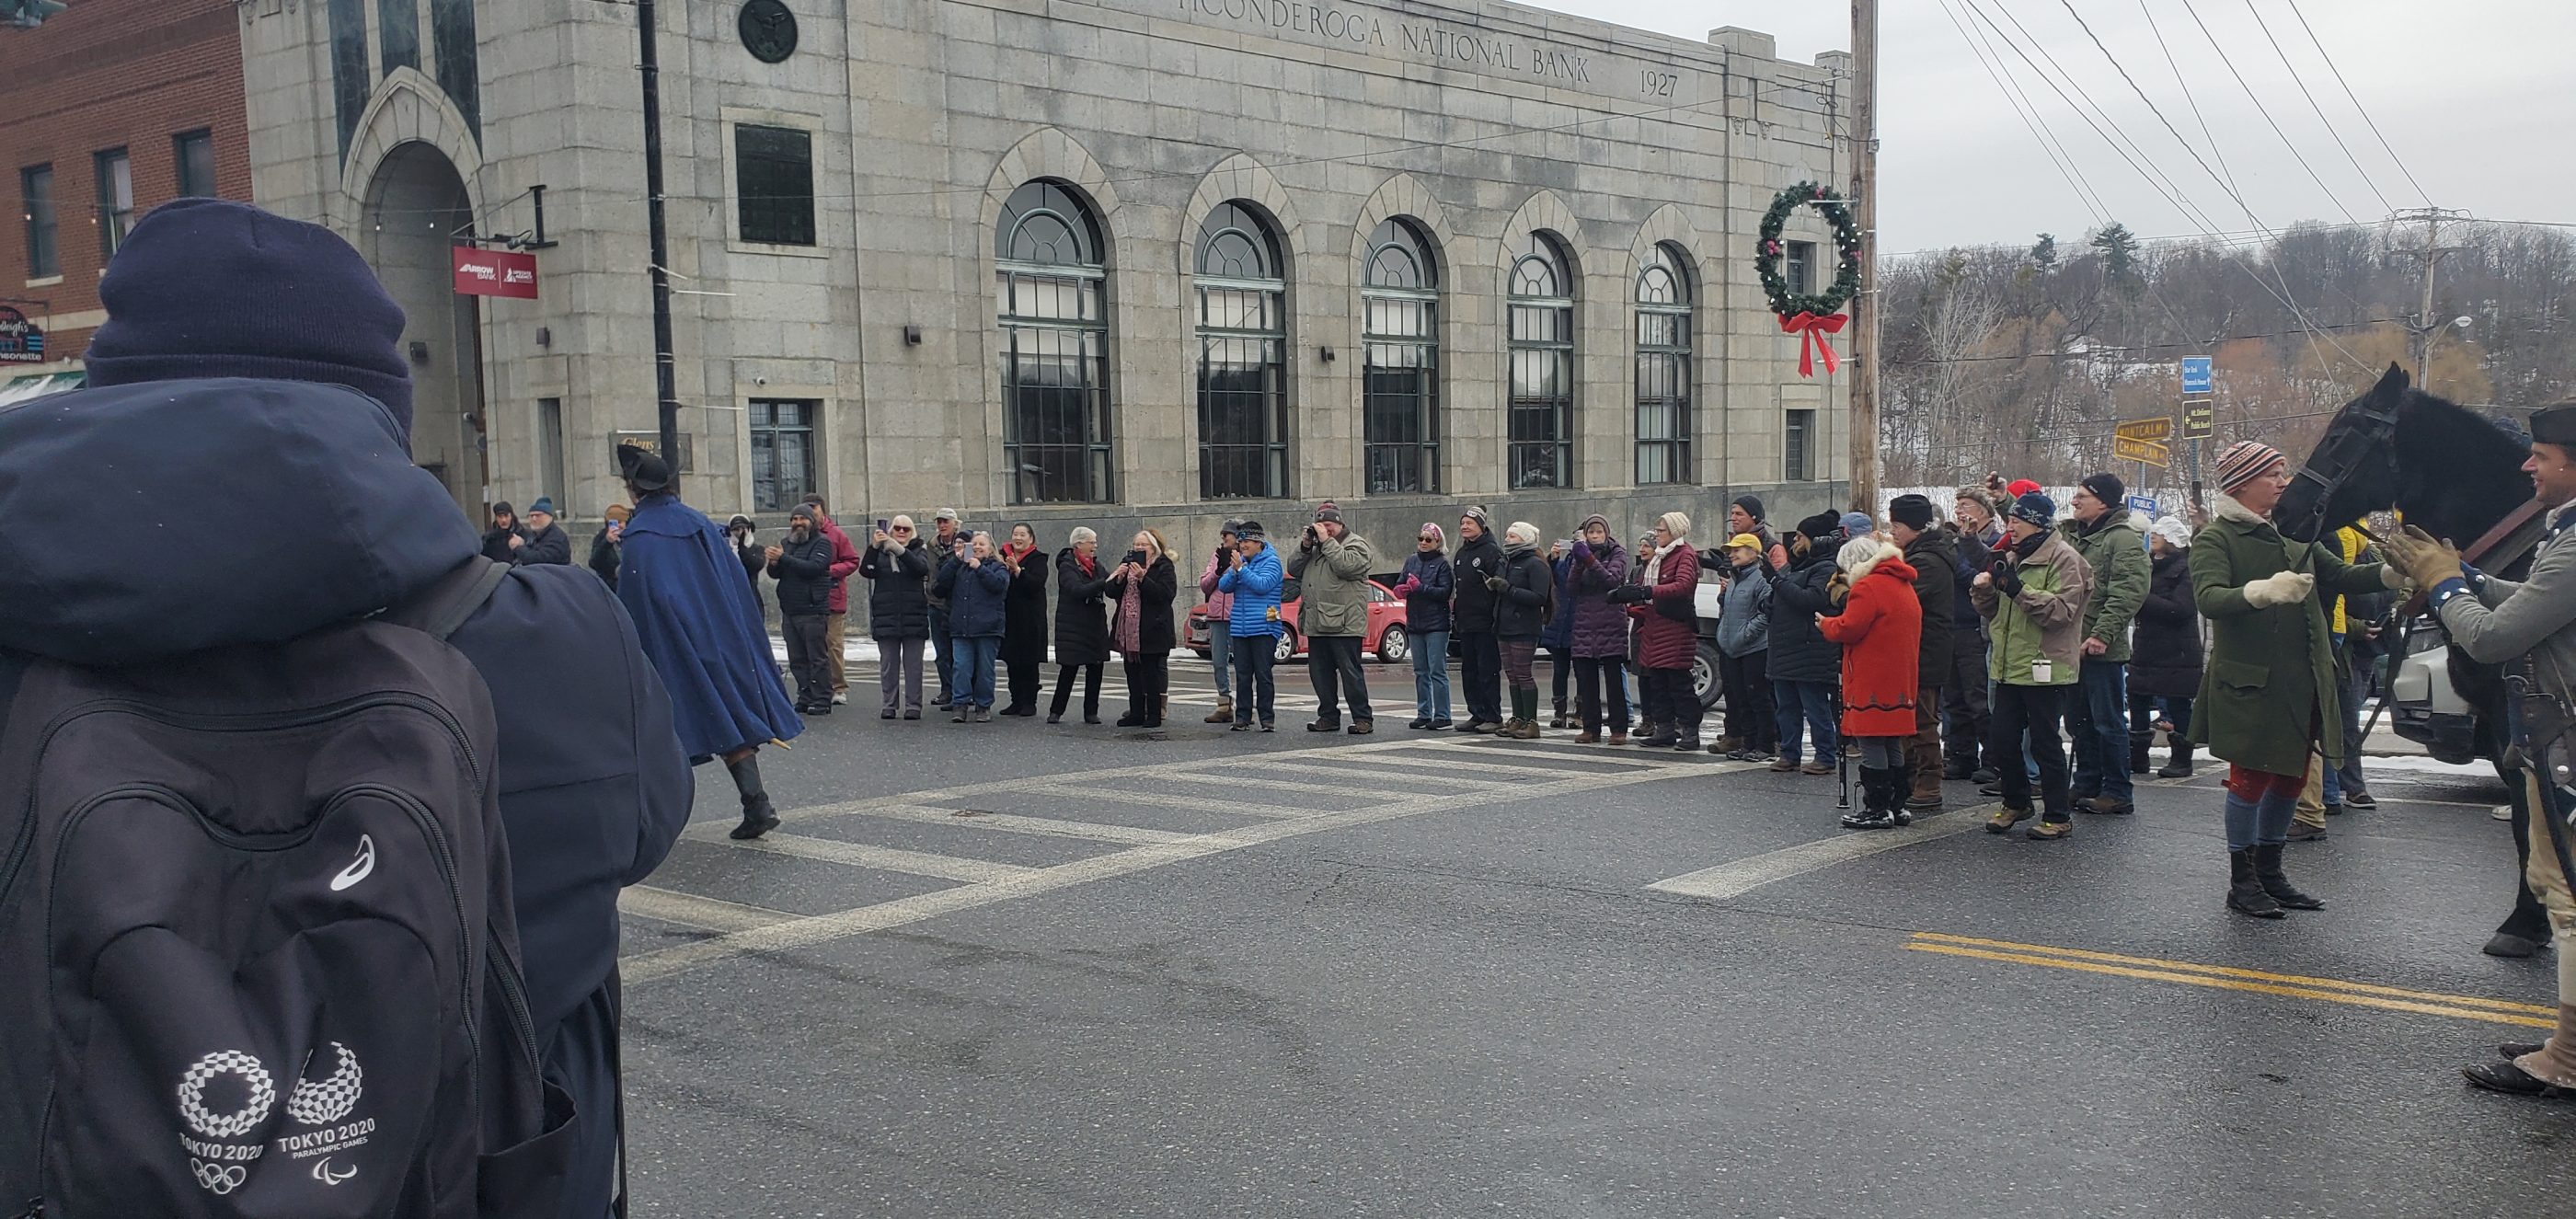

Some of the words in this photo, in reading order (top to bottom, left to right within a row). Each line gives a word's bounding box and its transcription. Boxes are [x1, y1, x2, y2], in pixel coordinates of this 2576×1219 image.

[1400, 23, 1521, 71] NATIONAL
[1533, 48, 1590, 83] BANK
[1640, 69, 1679, 98] 1927
[2119, 423, 2162, 437] MONTCALM
[2119, 441, 2158, 459] CHAMPLAIN
[2133, 499, 2152, 509] PUBLIC
[179, 1133, 222, 1158] TOKYO
[224, 1144, 263, 1160] 2020
[278, 1129, 336, 1152] TOKYO
[339, 1118, 375, 1141] 2020
[293, 1143, 341, 1159] PARALYMPIC
[342, 1136, 368, 1149] GAMES
